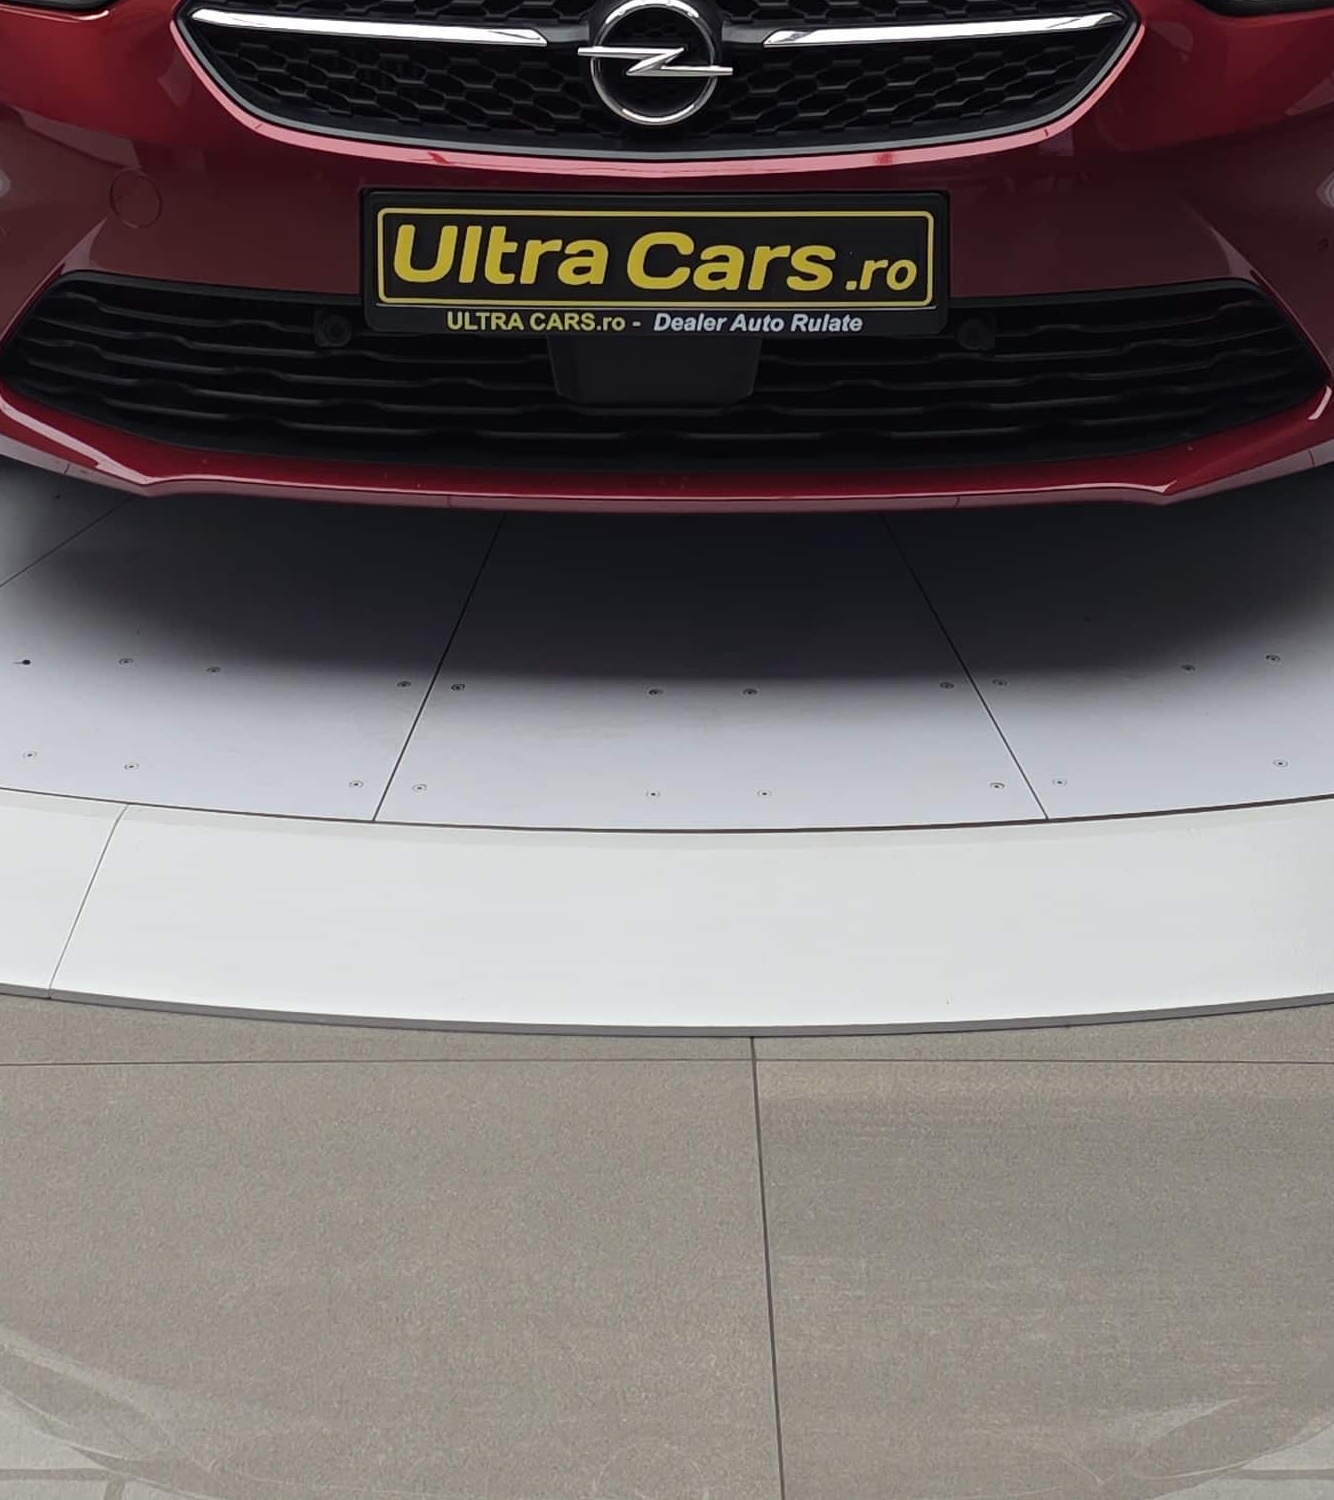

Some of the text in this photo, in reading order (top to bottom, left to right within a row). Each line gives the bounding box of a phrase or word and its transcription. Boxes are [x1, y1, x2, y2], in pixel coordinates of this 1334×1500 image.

[393, 224, 918, 292] Ultra Cars .ro
[446, 311, 524, 332] ULTRA
[529, 312, 627, 333] CARS.ro
[653, 311, 727, 332] Dealer
[729, 312, 784, 332] Auto
[790, 313, 863, 333] Rulate
